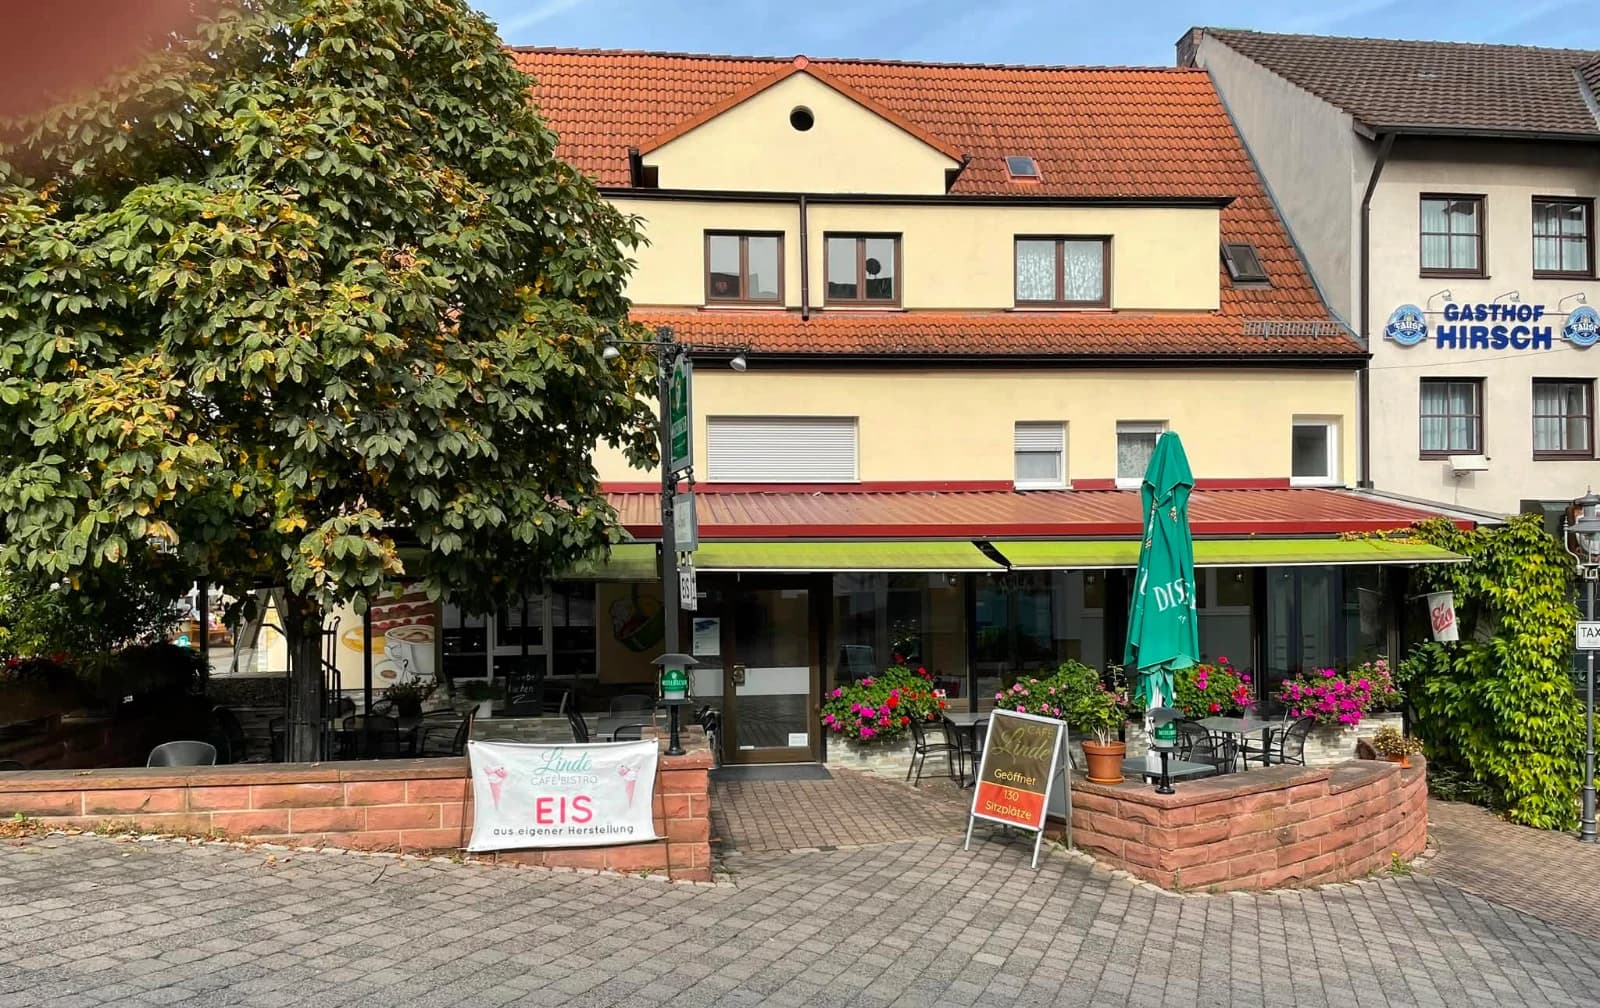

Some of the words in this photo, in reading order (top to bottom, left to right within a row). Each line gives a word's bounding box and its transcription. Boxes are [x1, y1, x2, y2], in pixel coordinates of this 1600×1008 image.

[1444, 303, 1545, 322] GASTHOF
[1436, 325, 1552, 350] HIRSCH
[991, 727, 1050, 765] Linde
[534, 747, 593, 780] Linde
[561, 775, 598, 786] BISTRO
[994, 768, 1036, 787] Geöffnet
[1003, 789, 1019, 802] 130
[535, 795, 593, 825] EIS
[985, 801, 1032, 820] Sitzplätze
[493, 827, 514, 836] aus
[518, 826, 563, 837] eigener
[568, 825, 634, 836] Herstellung
